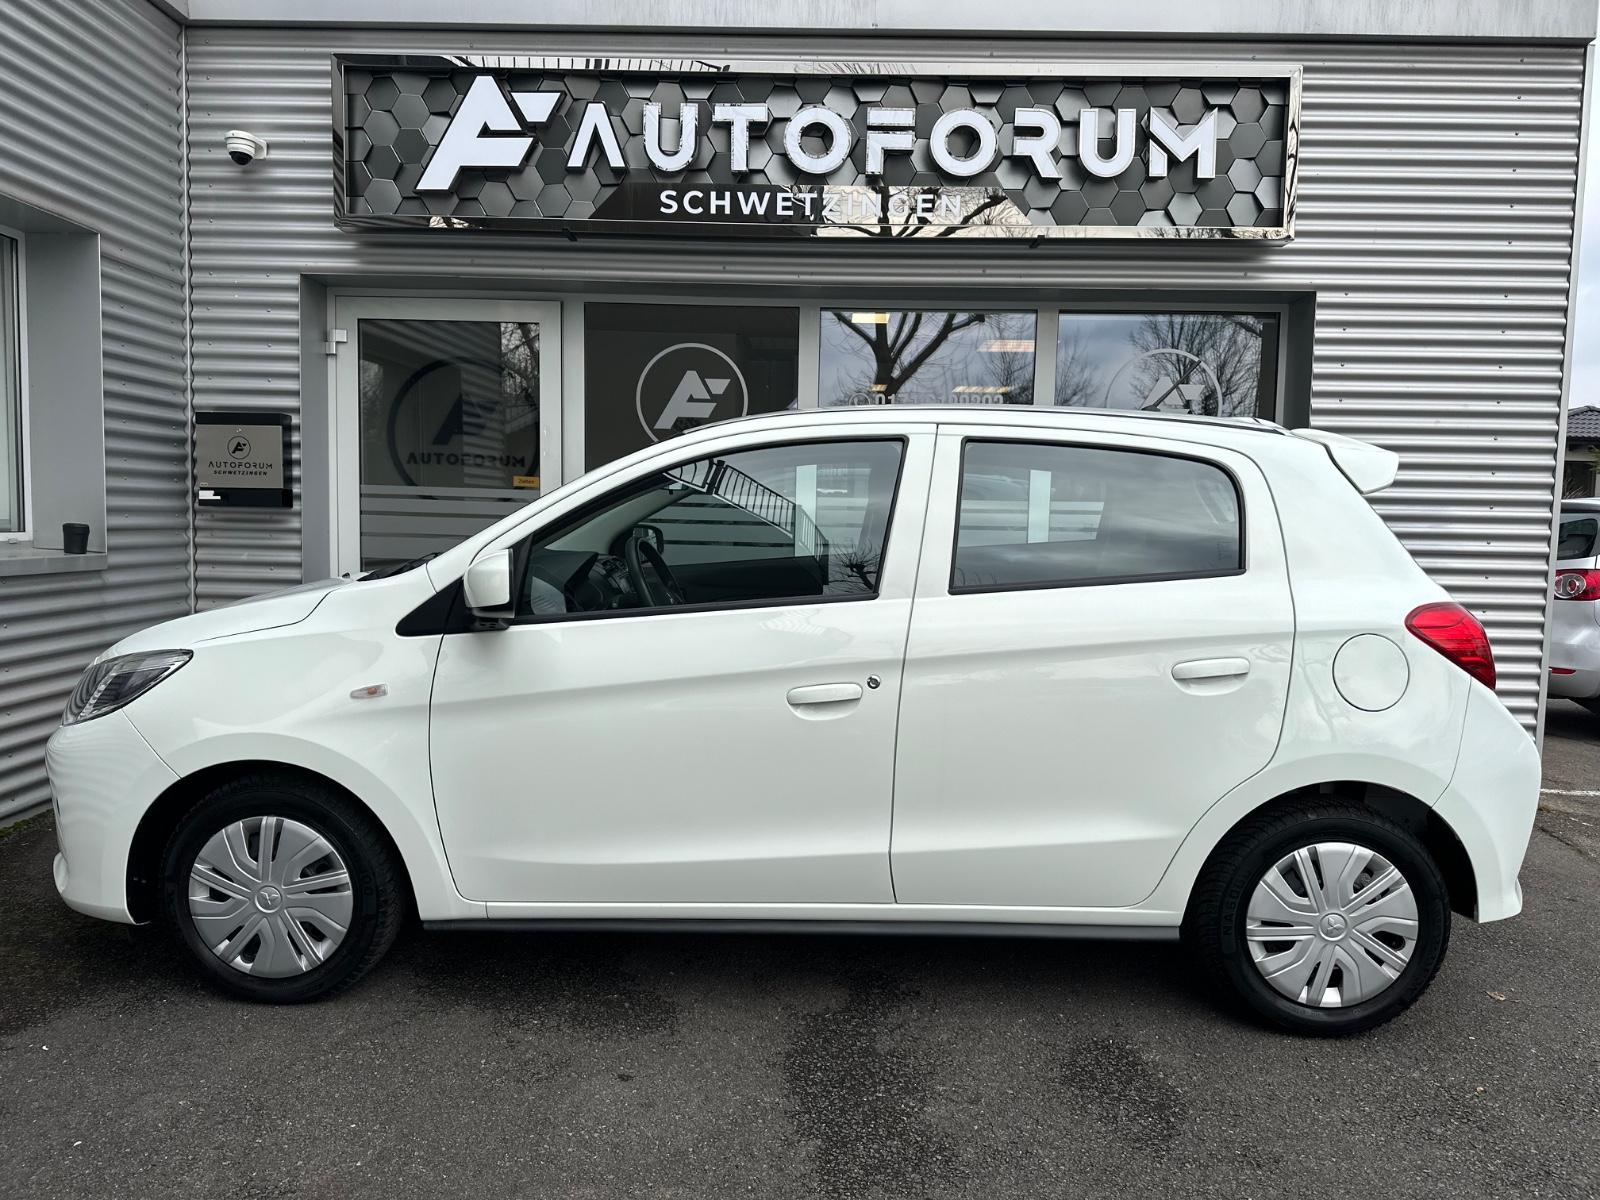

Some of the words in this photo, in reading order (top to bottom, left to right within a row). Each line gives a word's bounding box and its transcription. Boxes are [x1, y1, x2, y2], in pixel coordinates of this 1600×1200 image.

[565, 100, 1219, 181] AUTOFORUM
[659, 189, 963, 217] SCHWETZINGEN
[208, 461, 273, 469] AUTOFORUM
[406, 451, 527, 468] AUTOFORUM
